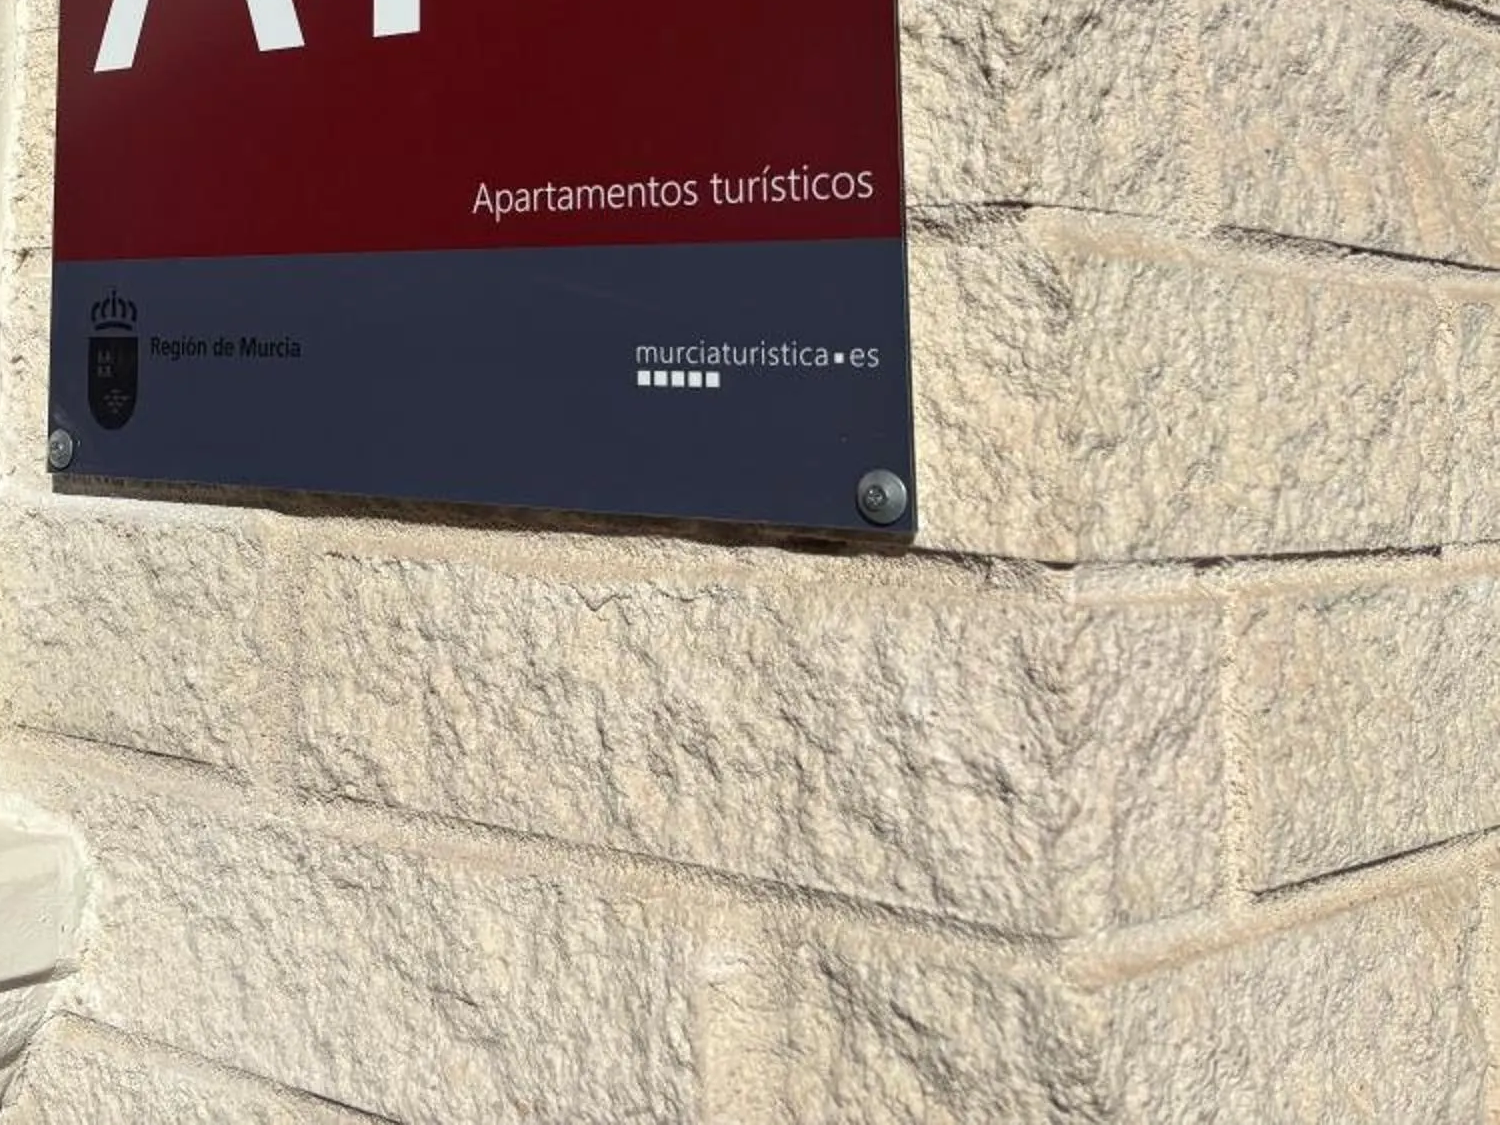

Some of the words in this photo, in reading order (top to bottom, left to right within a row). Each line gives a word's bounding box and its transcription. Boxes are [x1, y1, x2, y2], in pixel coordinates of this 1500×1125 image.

[472, 177, 699, 222] Apartamentos
[709, 164, 874, 205] turísticos
[150, 337, 207, 360] Región
[213, 338, 235, 357] de
[240, 337, 302, 358] Murcia
